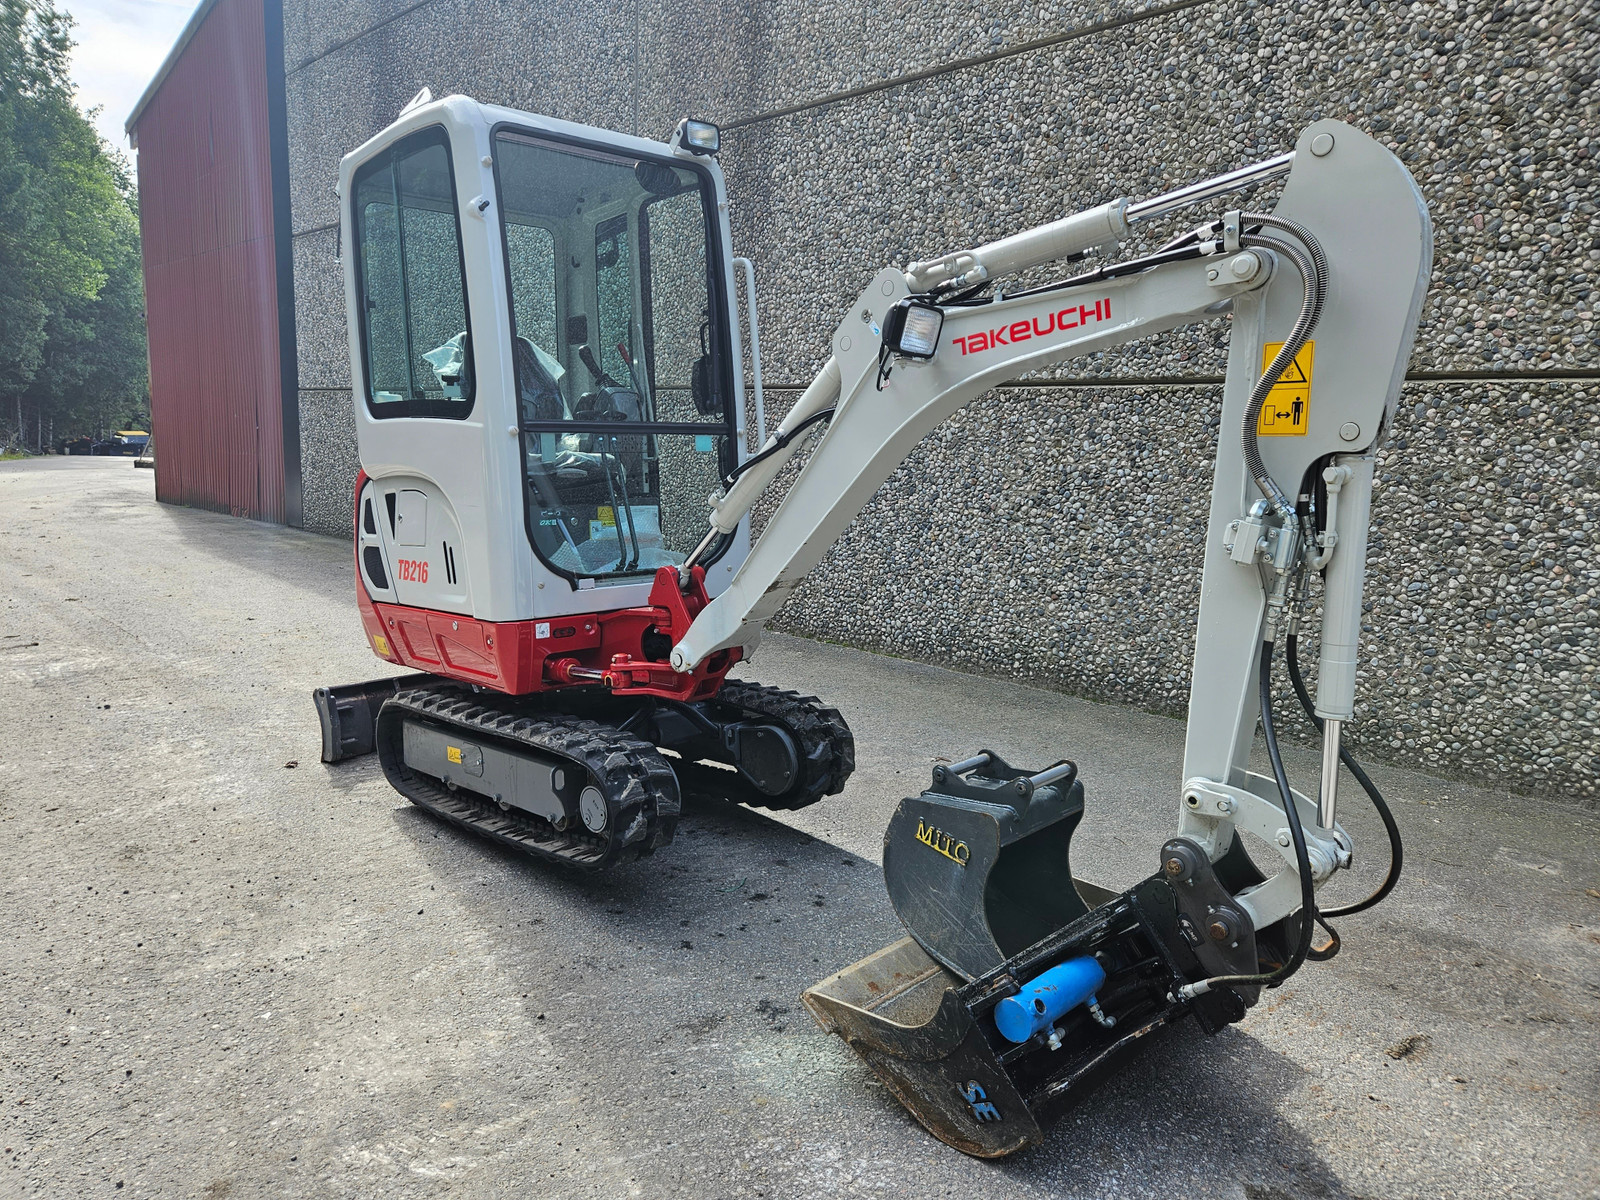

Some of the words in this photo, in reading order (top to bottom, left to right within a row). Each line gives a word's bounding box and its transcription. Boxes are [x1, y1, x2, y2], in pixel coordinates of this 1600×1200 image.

[952, 298, 1112, 356] TAKEUCHI
[398, 559, 429, 584] TB216
[914, 816, 970, 867] MITO
